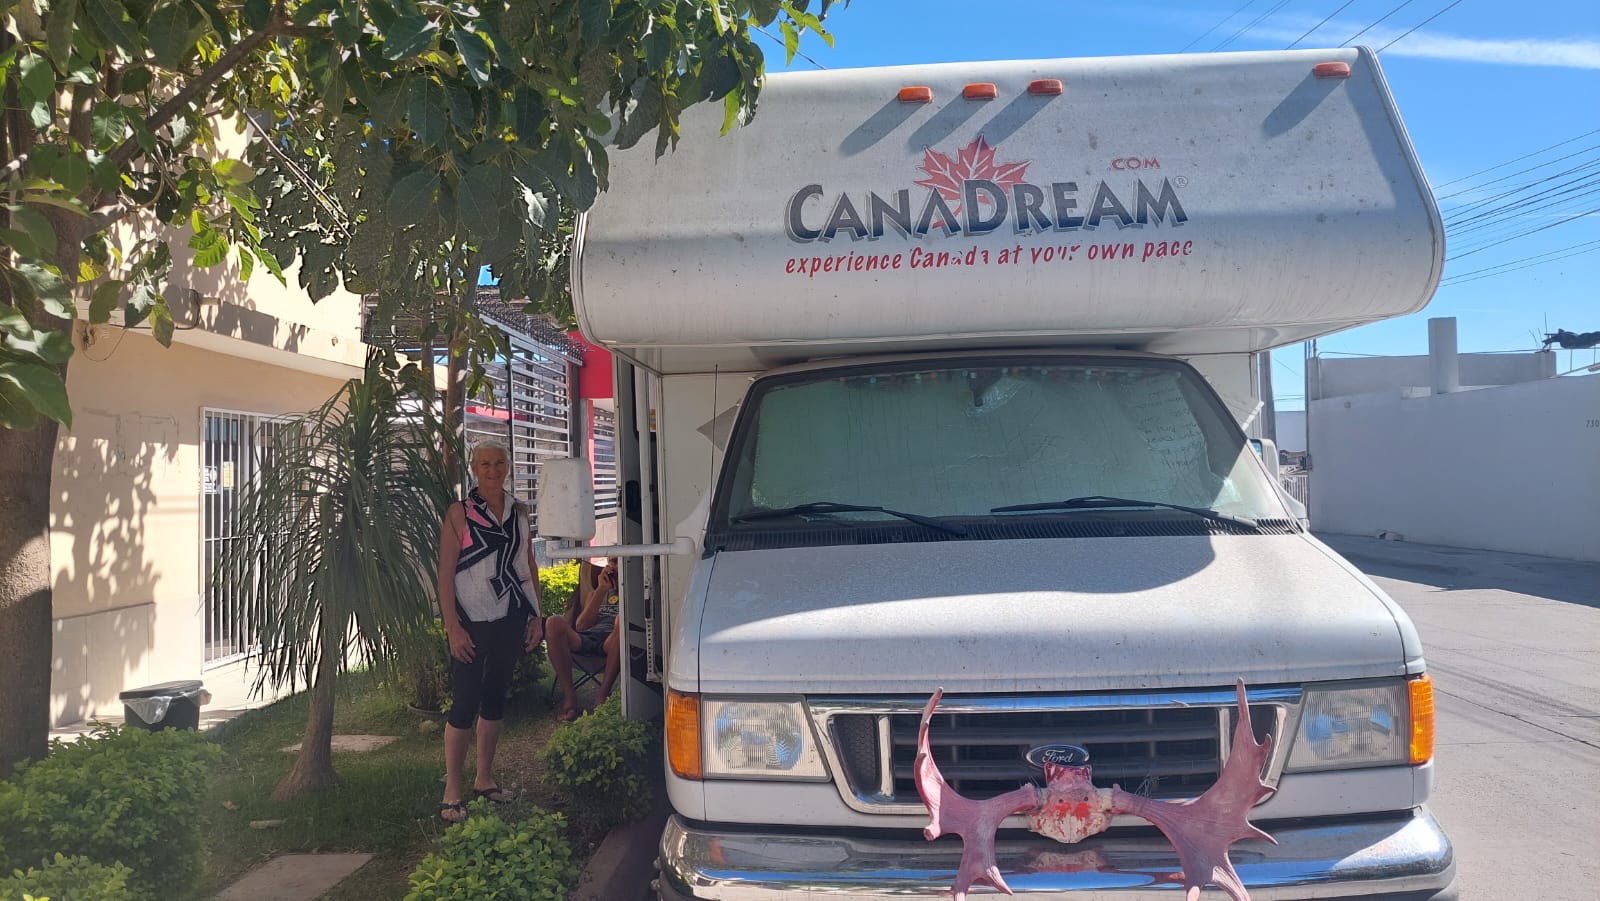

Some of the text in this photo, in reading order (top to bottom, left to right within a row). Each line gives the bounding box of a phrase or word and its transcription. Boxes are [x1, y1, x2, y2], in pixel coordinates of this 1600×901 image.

[785, 250, 902, 278] experience
[997, 244, 1024, 265] at
[1087, 242, 1135, 261] own
[1042, 749, 1074, 763] Ford
